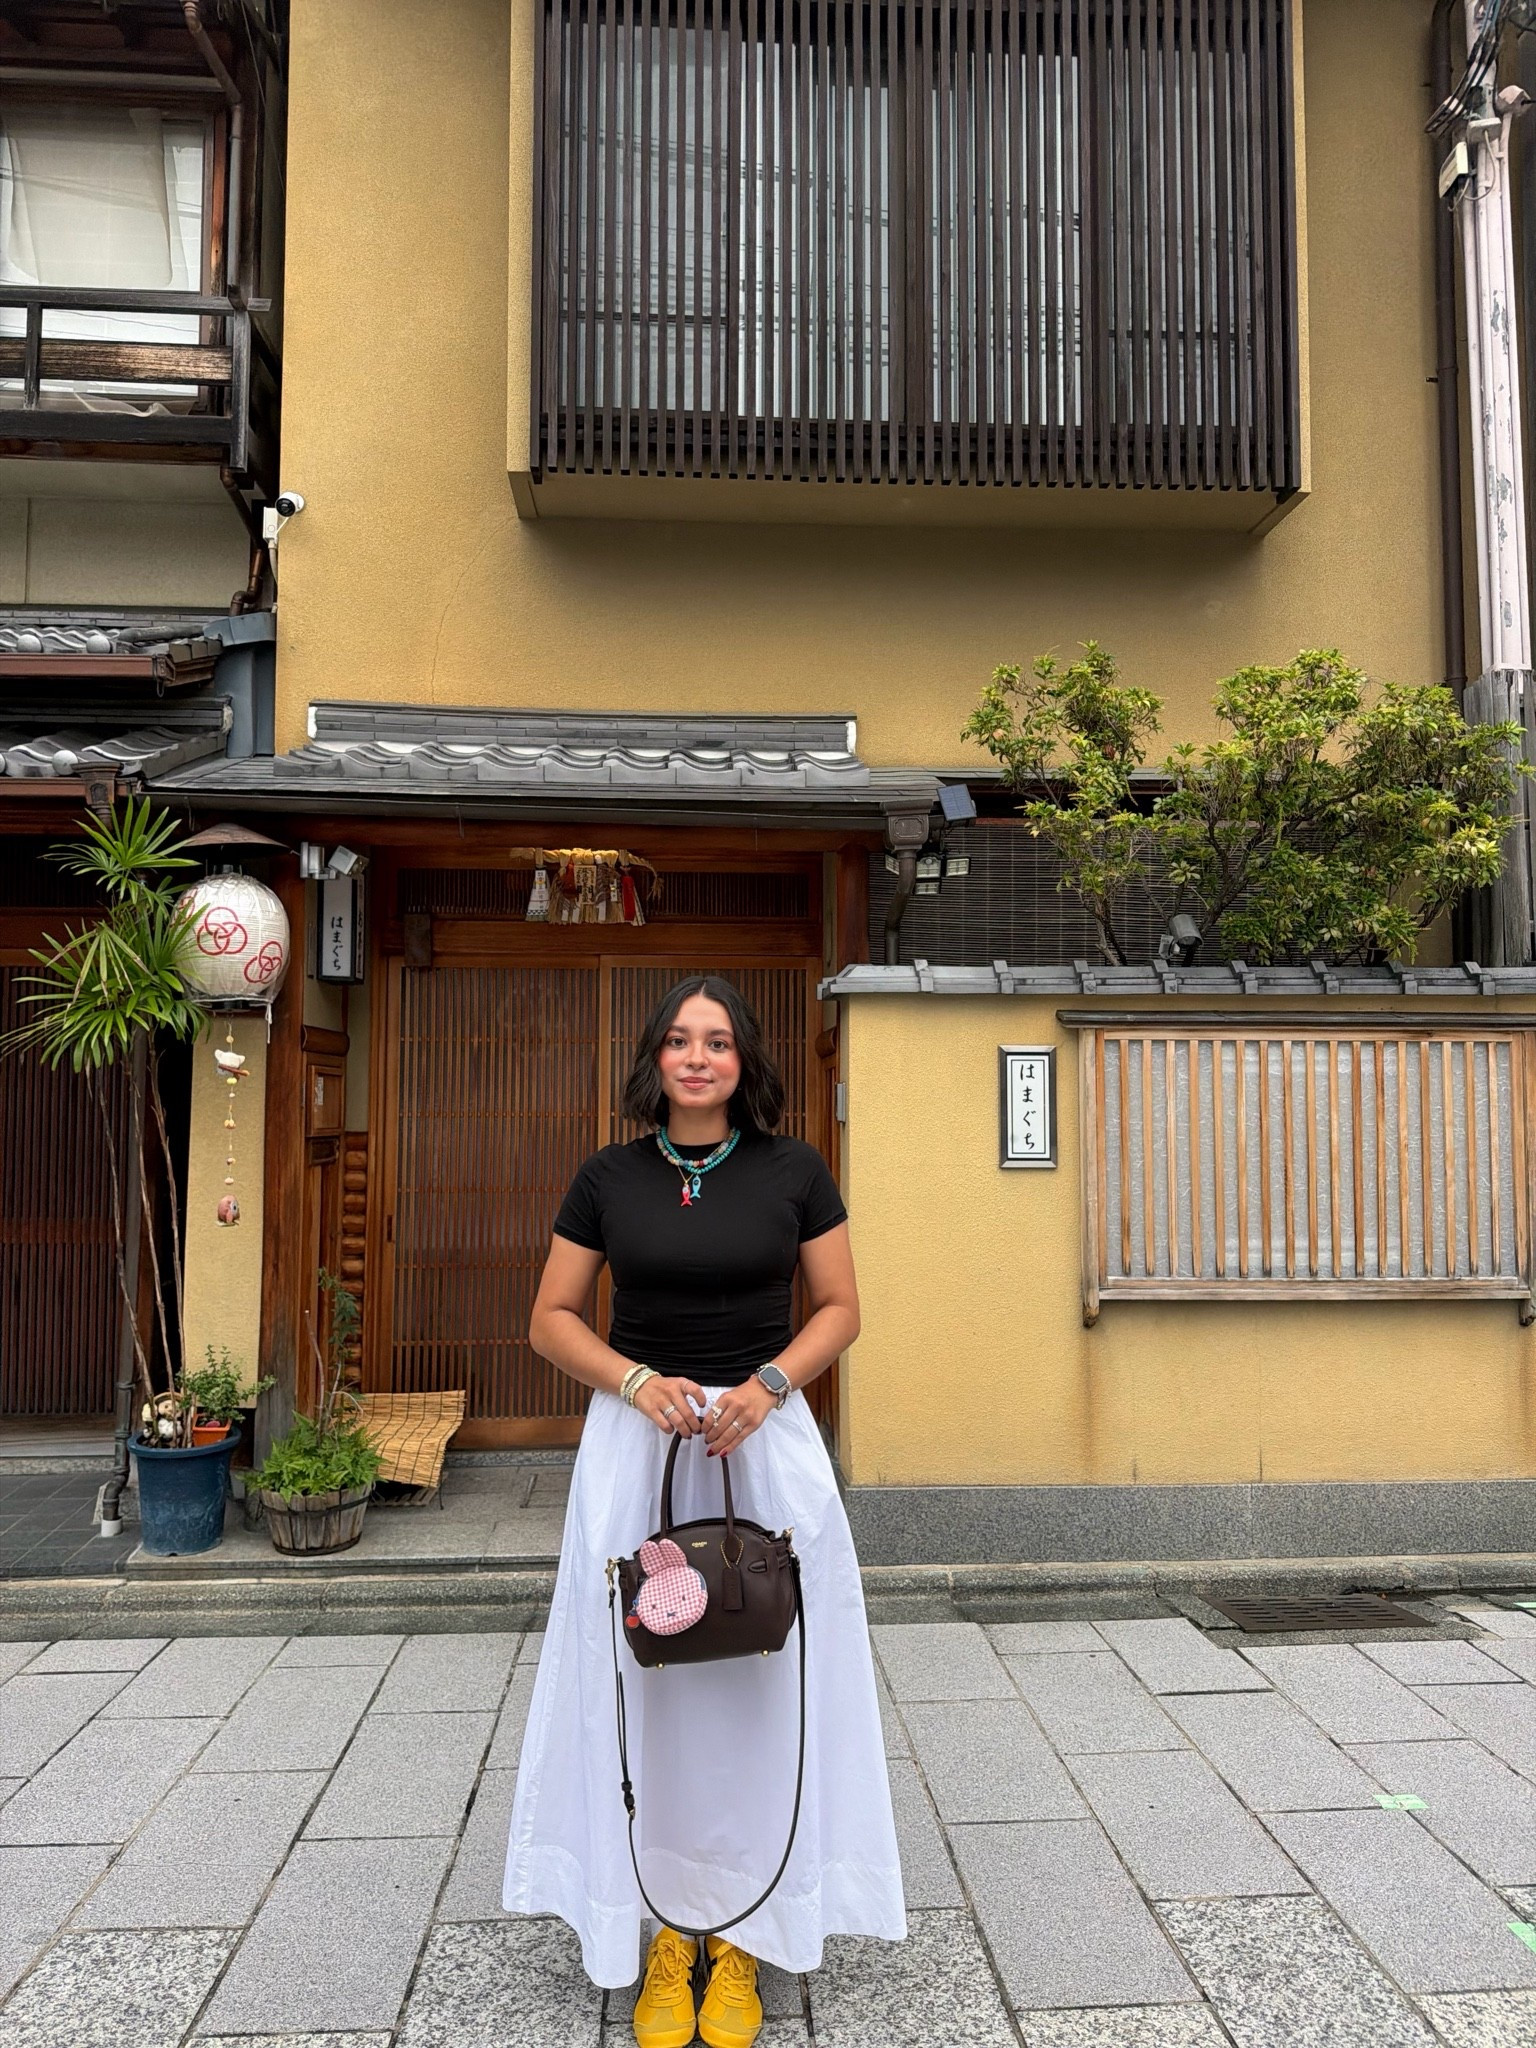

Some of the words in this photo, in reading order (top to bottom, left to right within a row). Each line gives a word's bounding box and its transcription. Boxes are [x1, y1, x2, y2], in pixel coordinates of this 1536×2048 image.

[331, 917, 343, 970] はまぐち
[1020, 1063, 1036, 1150] はまぐち
